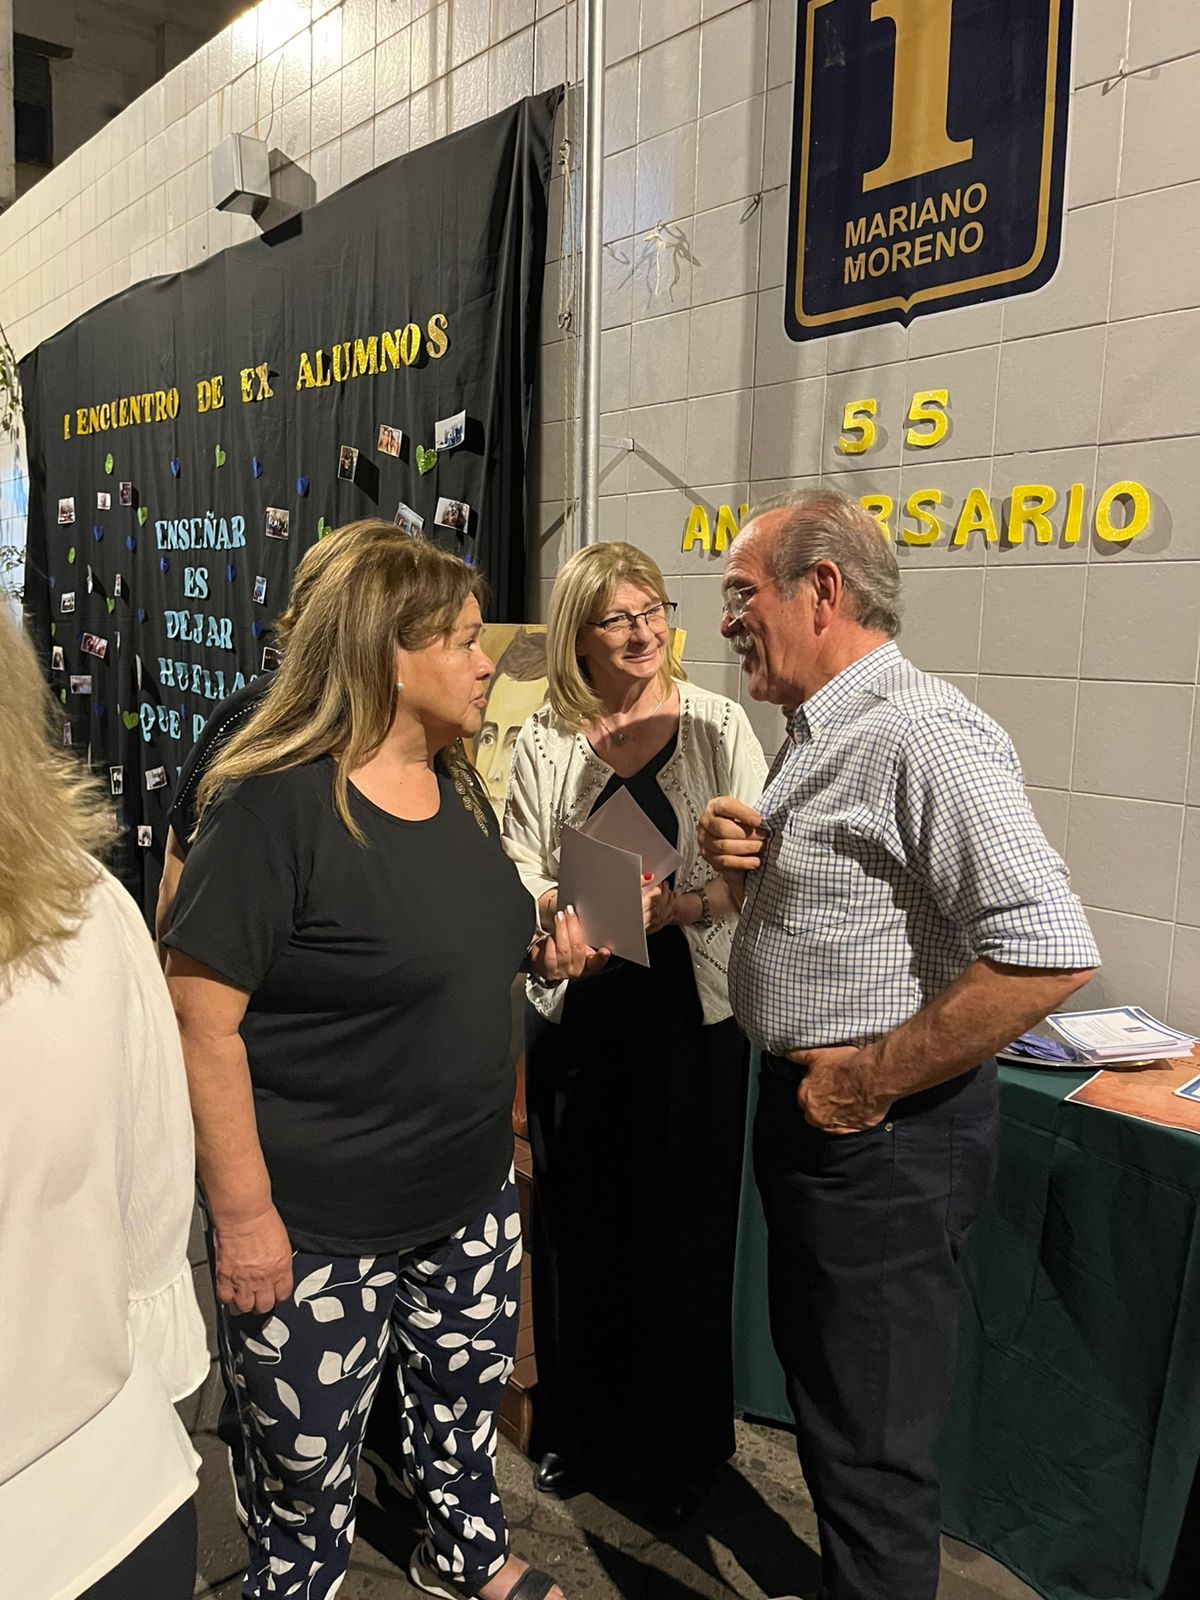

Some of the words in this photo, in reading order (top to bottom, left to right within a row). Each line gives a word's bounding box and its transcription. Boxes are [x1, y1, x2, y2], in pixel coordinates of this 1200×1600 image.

[863, 0, 973, 192] 1
[845, 182, 987, 249] MARIANO
[844, 221, 984, 285] MORENO
[196, 375, 224, 413] DE
[240, 362, 274, 402] EX
[296, 313, 448, 391] ALUMNOS
[155, 510, 247, 550] ENSEÑAR
[184, 566, 209, 599] ES
[164, 610, 233, 650] DEJAR
[140, 702, 181, 742] QUE
